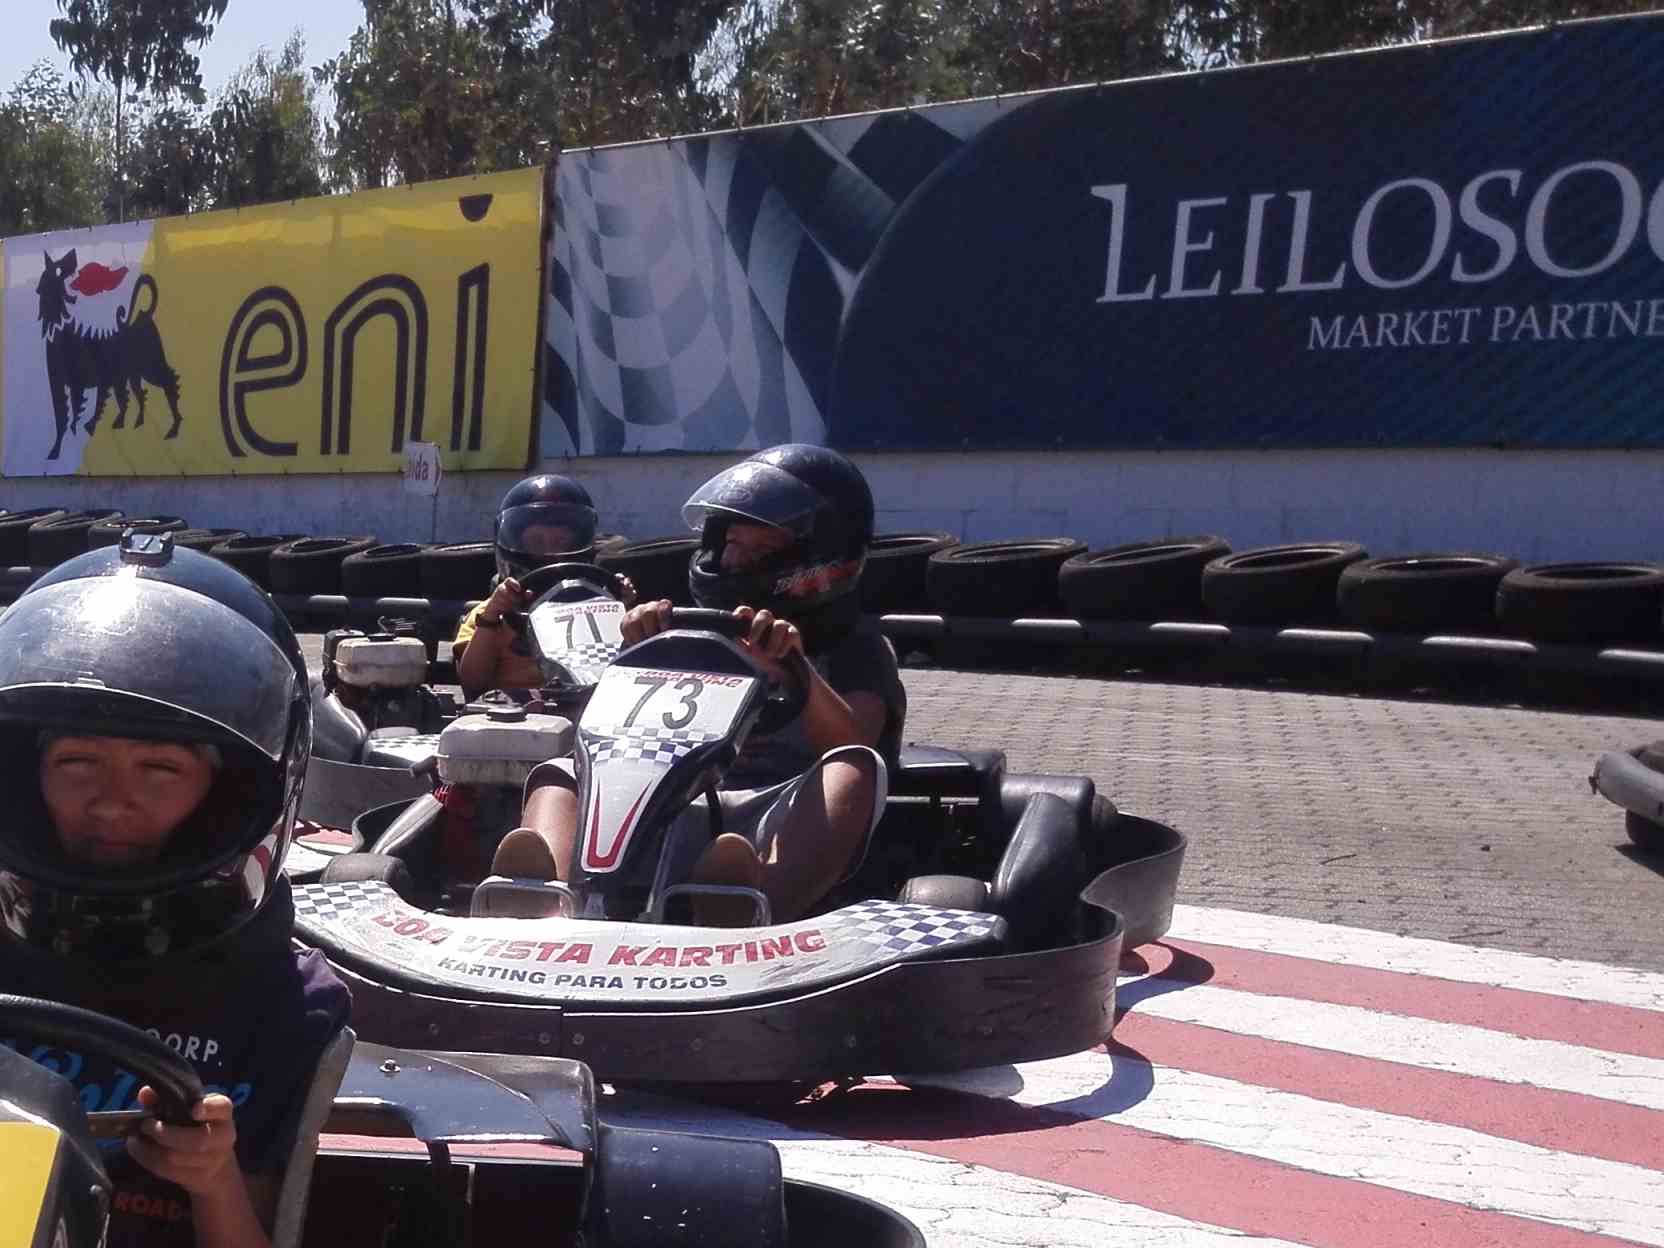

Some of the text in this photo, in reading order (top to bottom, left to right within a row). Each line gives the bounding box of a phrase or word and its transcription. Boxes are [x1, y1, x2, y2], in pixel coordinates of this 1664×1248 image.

[219, 194, 493, 458] eni
[1306, 307, 1481, 350] MARKET
[553, 608, 603, 651] 71
[623, 677, 705, 730] 73
[607, 928, 828, 968] KARTING
[437, 957, 729, 991] KARTING PARA TODOS
